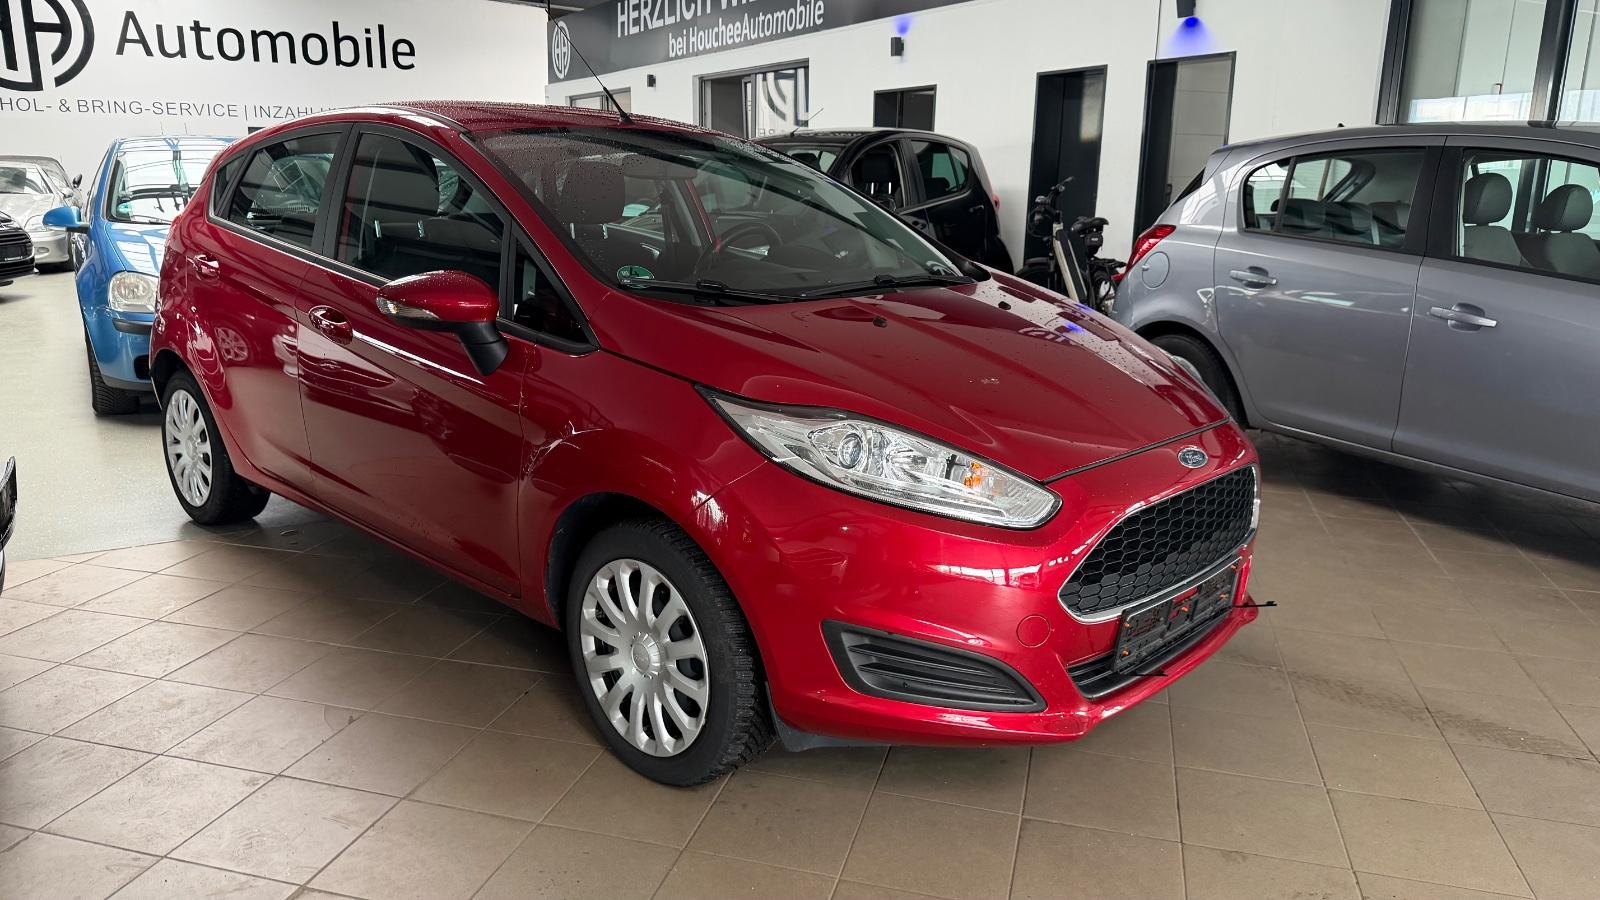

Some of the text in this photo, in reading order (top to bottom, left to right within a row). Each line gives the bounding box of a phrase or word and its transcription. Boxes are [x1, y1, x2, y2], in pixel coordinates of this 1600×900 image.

[115, 10, 416, 70] Automobile
[668, 0, 824, 58] bei HoucheeAutomobile
[58, 98, 72, 113] &
[77, 99, 238, 118] BRING-SERVICE
